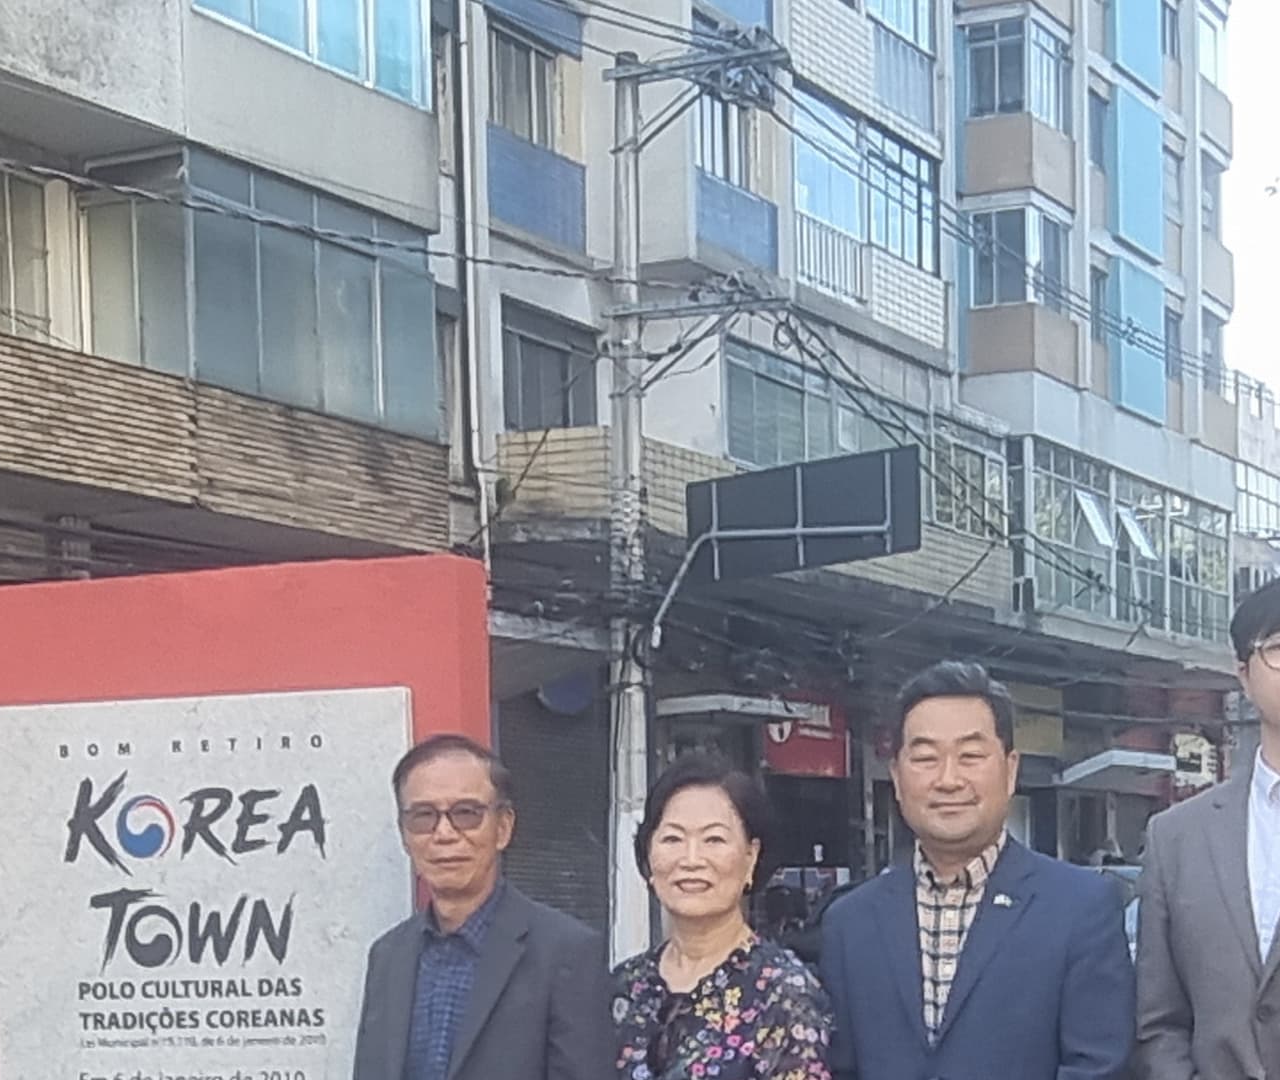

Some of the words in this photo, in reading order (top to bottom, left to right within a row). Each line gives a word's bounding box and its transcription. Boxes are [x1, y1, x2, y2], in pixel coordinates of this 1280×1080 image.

[59, 743, 131, 758] BOM
[172, 734, 323, 753] RETIRO
[64, 769, 327, 878] KOREA
[89, 887, 296, 977] TOWN
[78, 981, 135, 1000] POLO
[141, 979, 252, 999] CULTURAL
[257, 977, 302, 998] DAS
[79, 1007, 200, 1034] TRADIÇÕES
[206, 1008, 326, 1029] COREANAS
